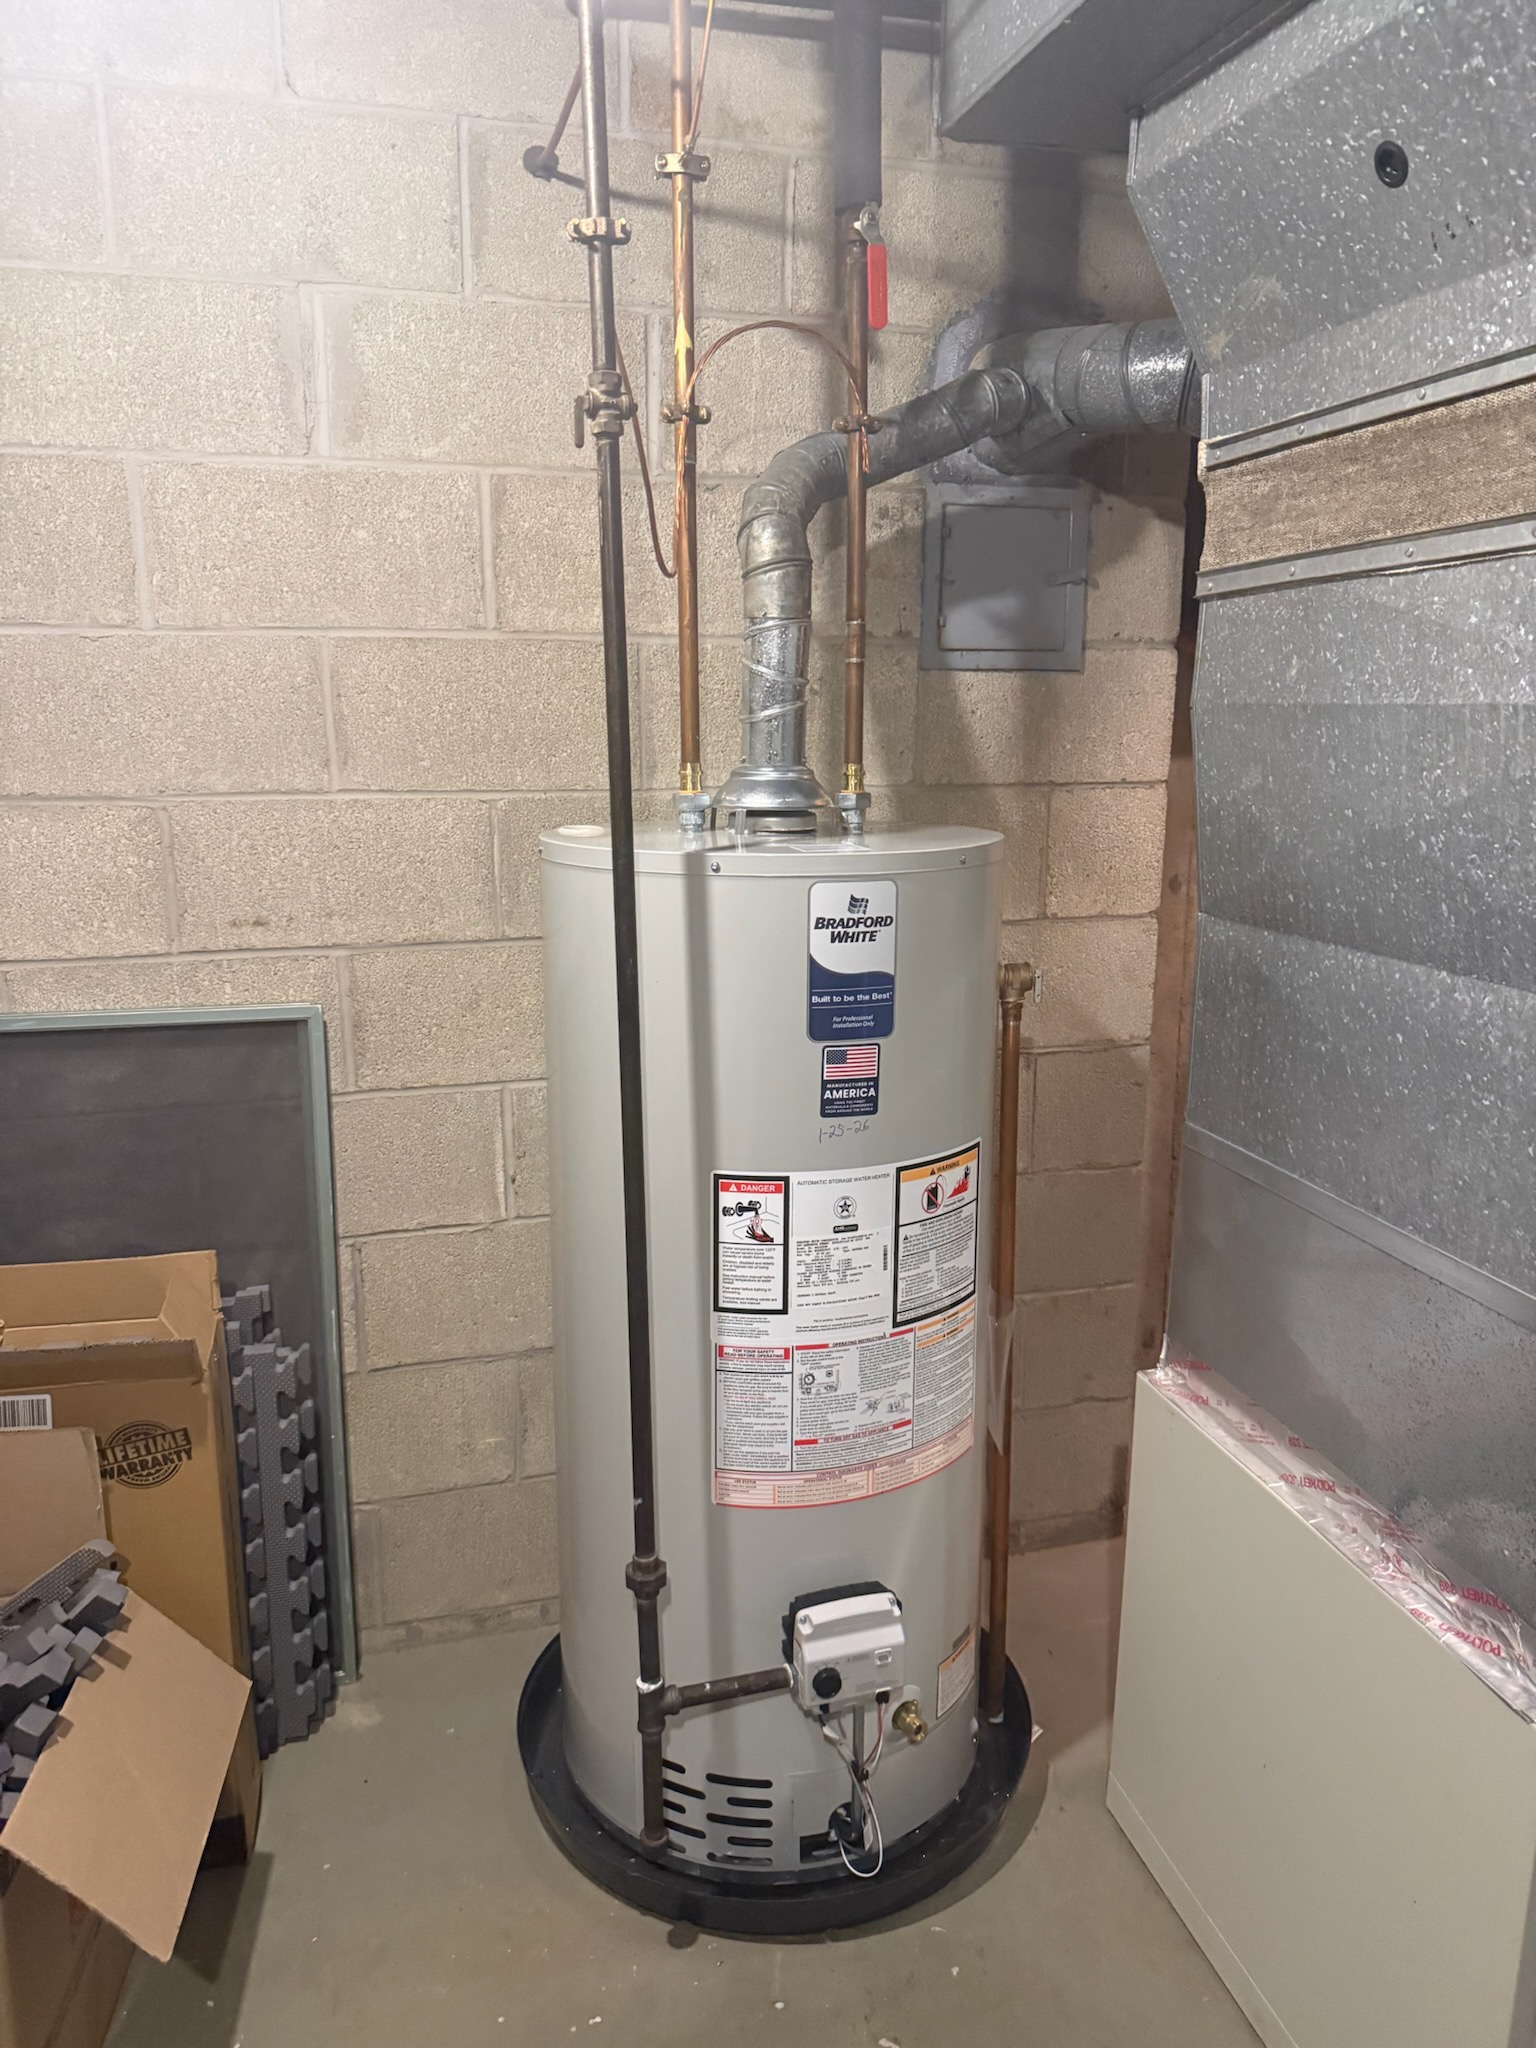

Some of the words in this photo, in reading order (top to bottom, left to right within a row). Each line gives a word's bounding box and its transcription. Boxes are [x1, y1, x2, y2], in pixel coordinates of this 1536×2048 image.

[814, 916, 894, 930] BRADFORD
[812, 995, 831, 1003] Built
[833, 994, 842, 1002] to
[844, 994, 855, 1002] be
[857, 993, 870, 1001] the
[824, 1087, 876, 1099] AMERICA
[829, 1177, 853, 1185] STORAGE
[872, 1172, 890, 1180] HEATER
[741, 1184, 776, 1192] DANGER
[832, 1339, 857, 1348] OPERATING
[100, 1447, 192, 1480] WARRANTY
